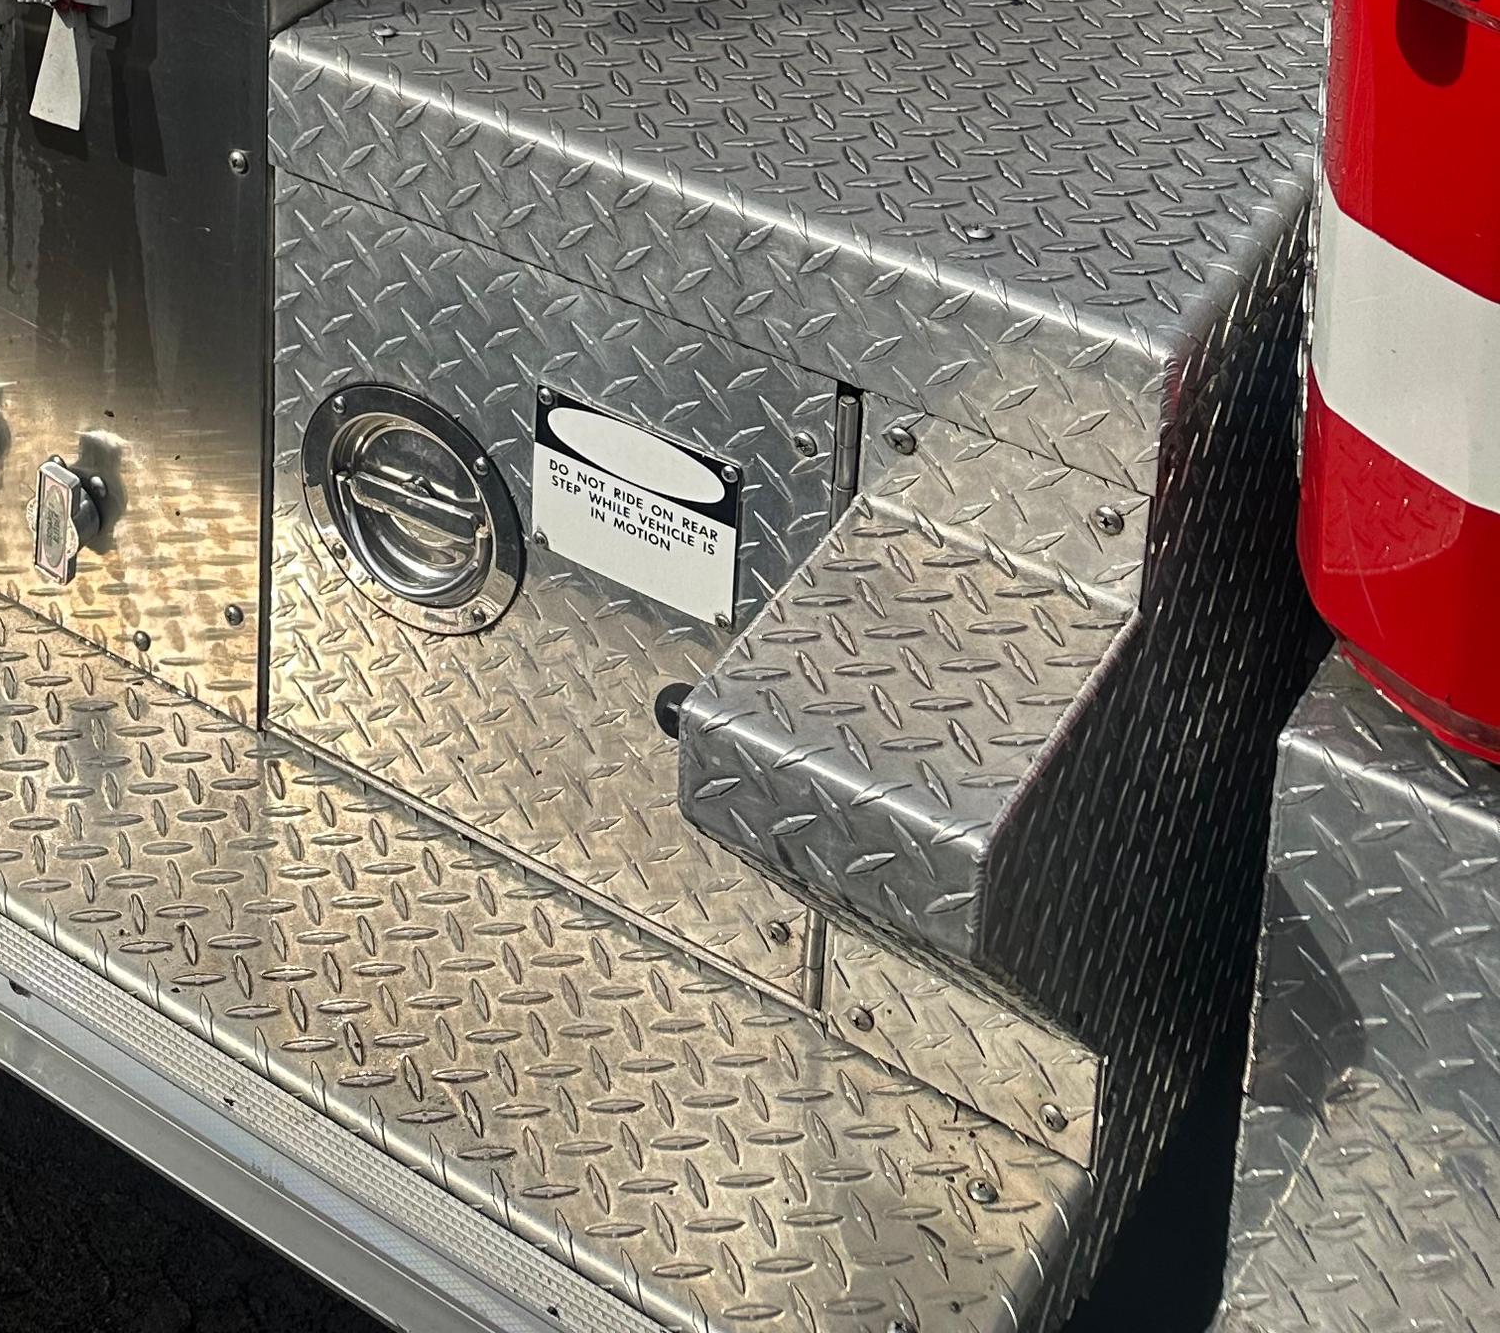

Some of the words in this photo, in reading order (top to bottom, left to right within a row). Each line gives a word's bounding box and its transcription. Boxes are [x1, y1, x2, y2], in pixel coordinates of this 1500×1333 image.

[549, 458, 569, 476] DO
[577, 471, 606, 492] NOT
[614, 487, 644, 510] RIDE
[651, 504, 673, 522] ON
[682, 517, 718, 542] REAR
[551, 475, 581, 495] STEP
[589, 490, 631, 518] WHILE
[639, 512, 695, 547] VEHICLE
[703, 541, 715, 555] IS
[591, 507, 606, 523] IN
[613, 520, 671, 552] MOTION
